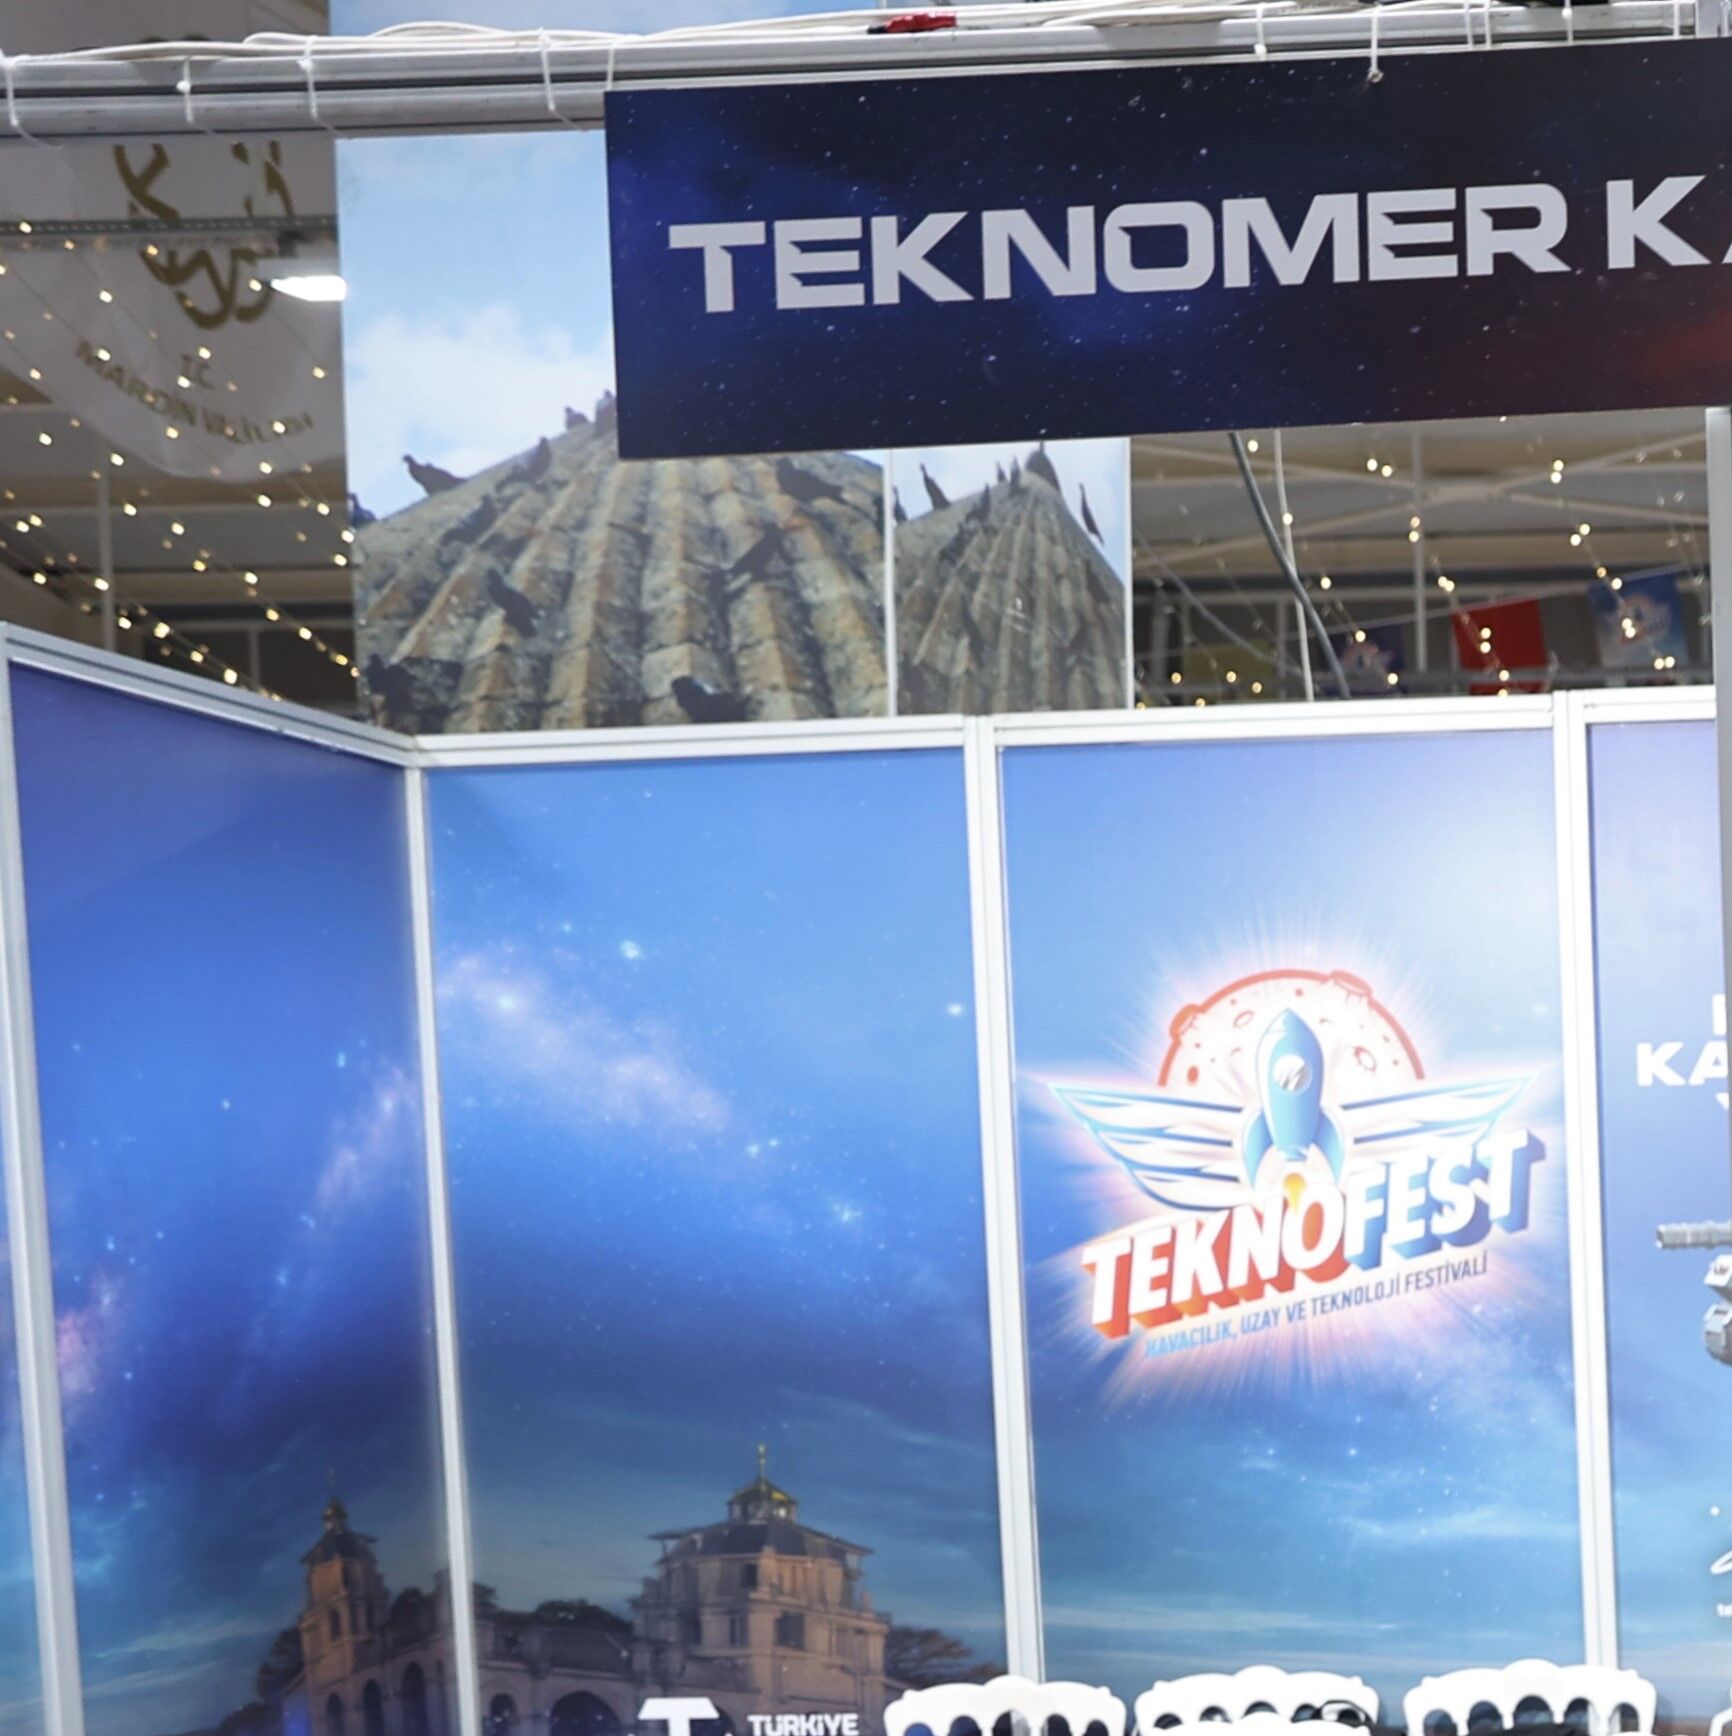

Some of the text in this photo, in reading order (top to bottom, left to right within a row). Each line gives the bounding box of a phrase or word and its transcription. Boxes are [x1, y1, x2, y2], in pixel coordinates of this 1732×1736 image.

[668, 182, 1571, 315] TEKNOMER
[1081, 1129, 1547, 1339] TEKNOFEST
[1146, 1251, 1488, 1358] HAVACILIK, UZAY VE TEKNOLOJİ FESTİVALİ
